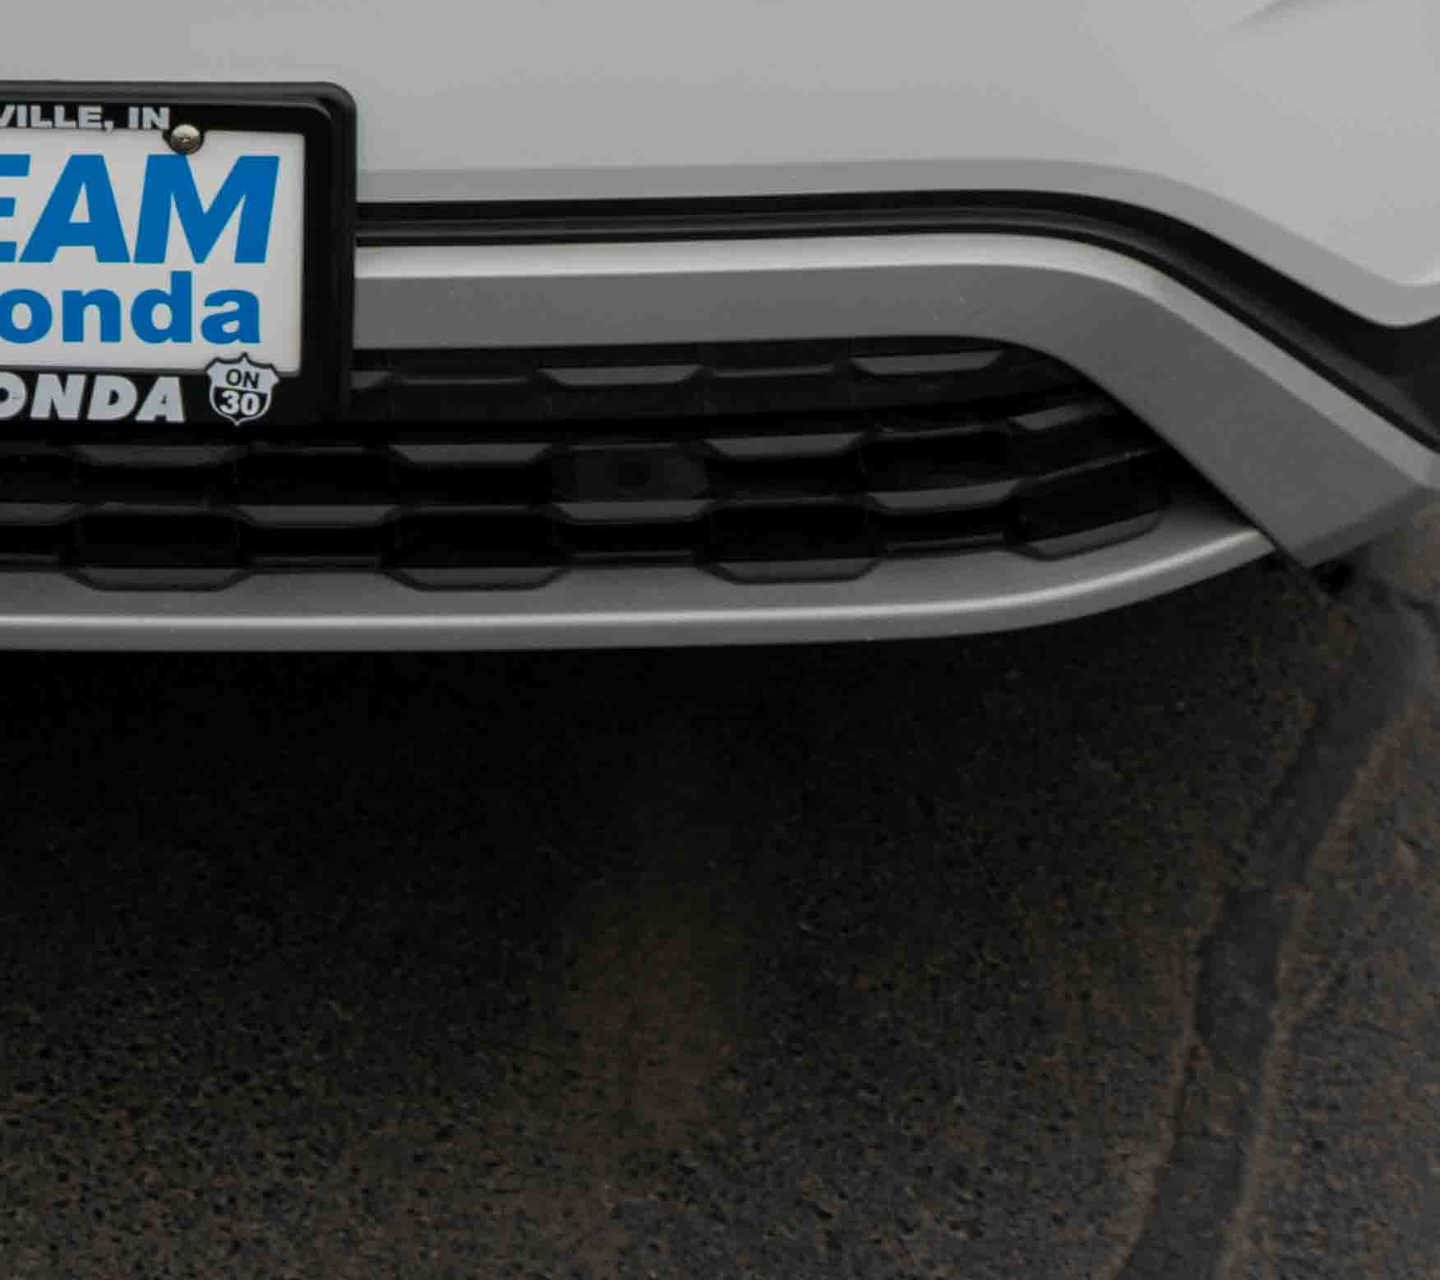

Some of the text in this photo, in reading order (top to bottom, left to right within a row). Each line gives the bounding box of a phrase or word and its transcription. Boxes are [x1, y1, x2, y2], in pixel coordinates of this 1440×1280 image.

[127, 106, 171, 132] IN
[225, 368, 261, 390] ON
[219, 389, 261, 417] 30
